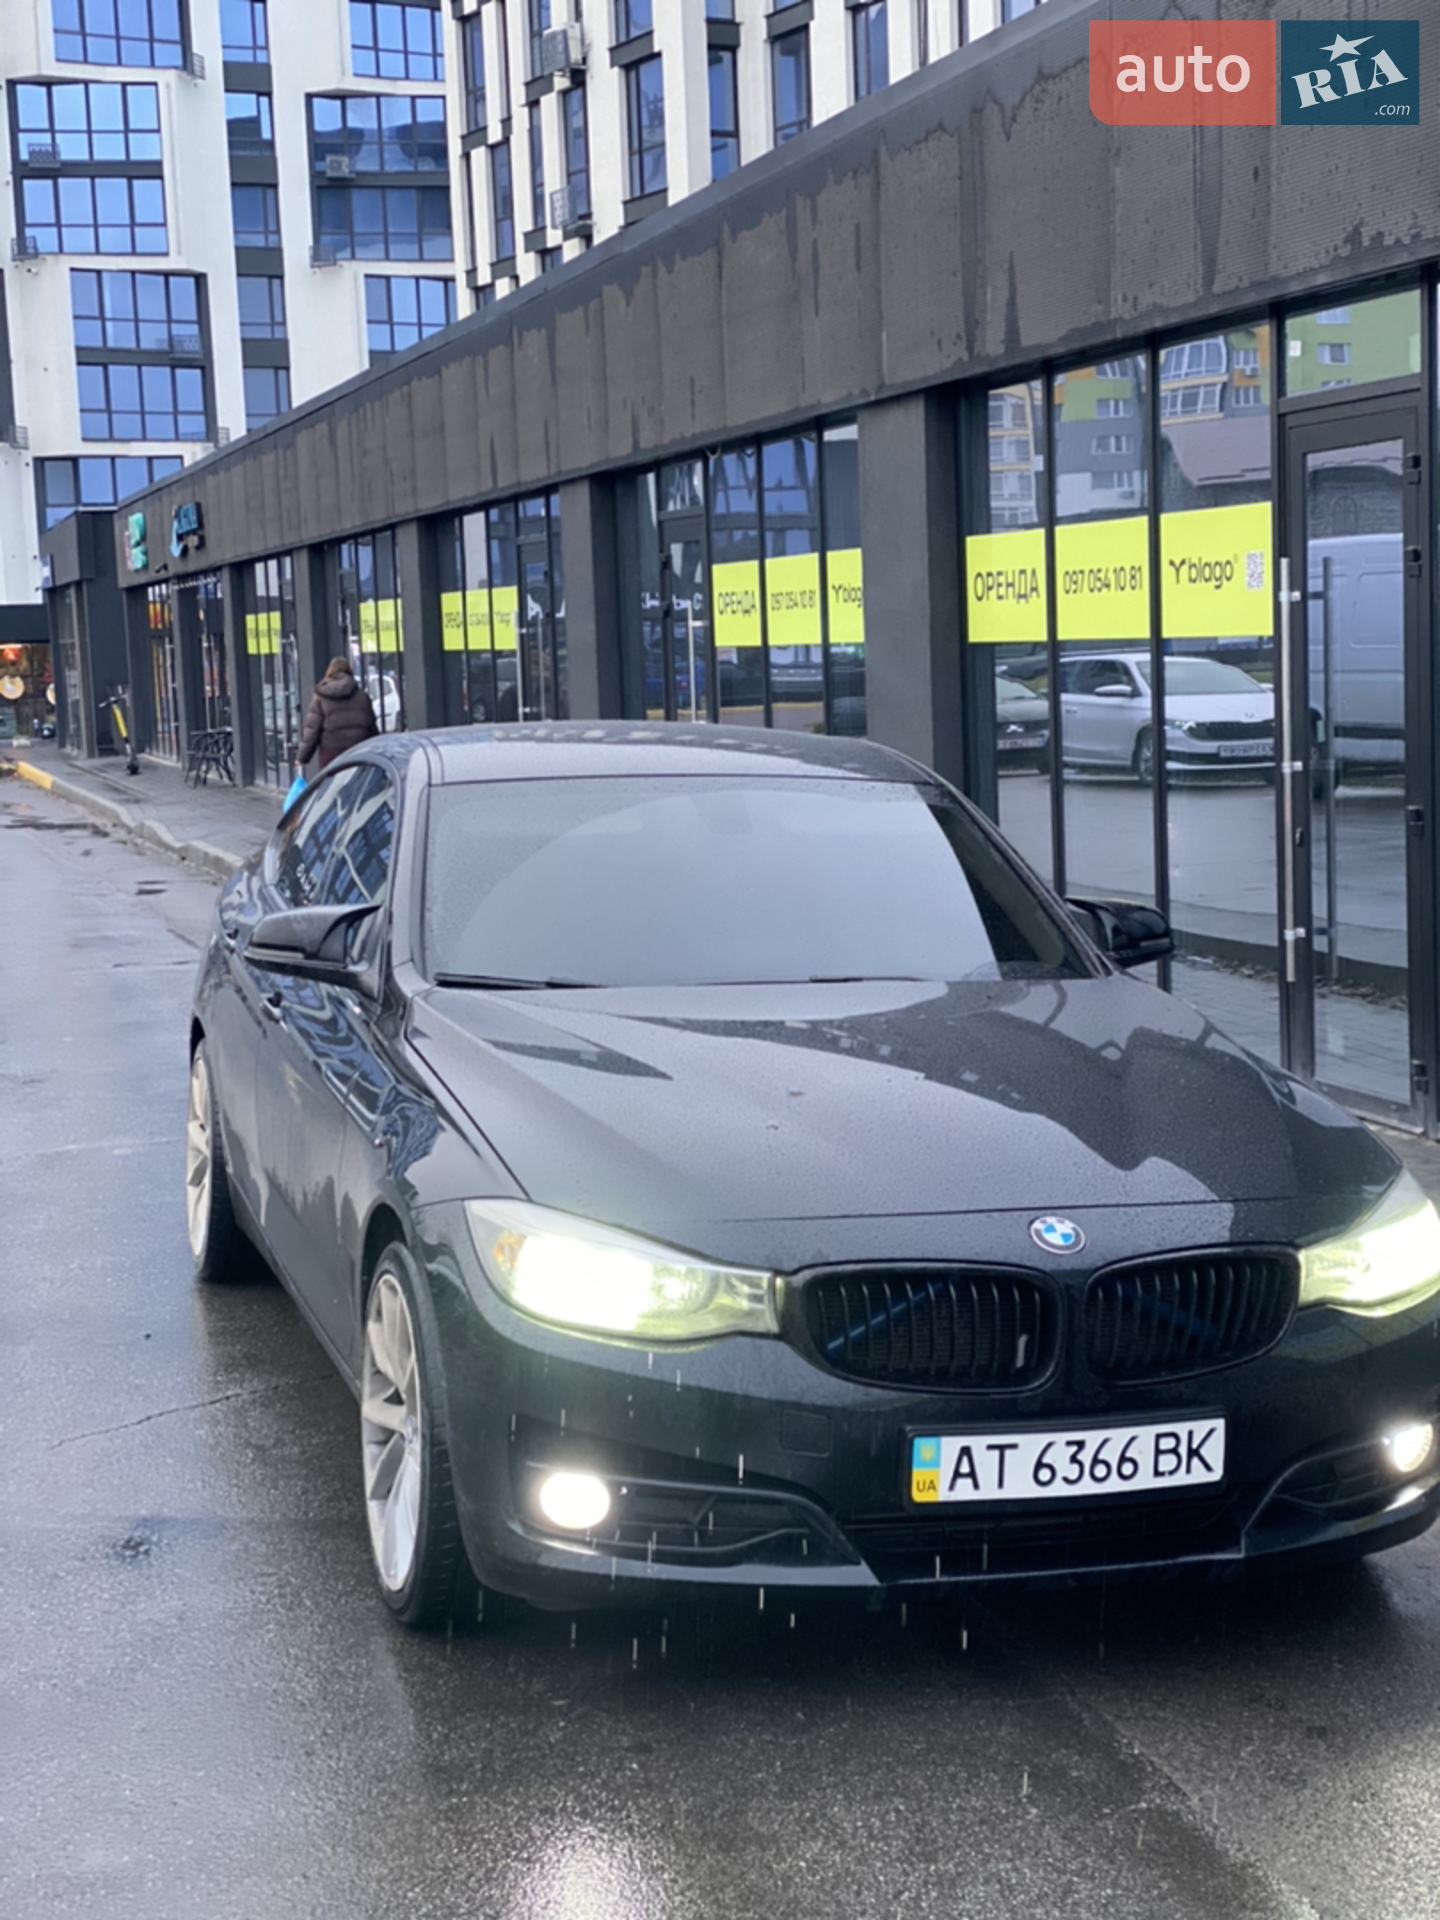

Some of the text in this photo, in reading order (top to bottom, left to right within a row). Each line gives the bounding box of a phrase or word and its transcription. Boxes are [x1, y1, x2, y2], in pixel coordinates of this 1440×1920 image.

[973, 567, 1040, 604] ОРЕНДА
[1063, 565, 1142, 595] 097 054 10 81
[948, 1427, 1217, 1492] AT 6366 BK
[916, 1482, 937, 1493] UA
